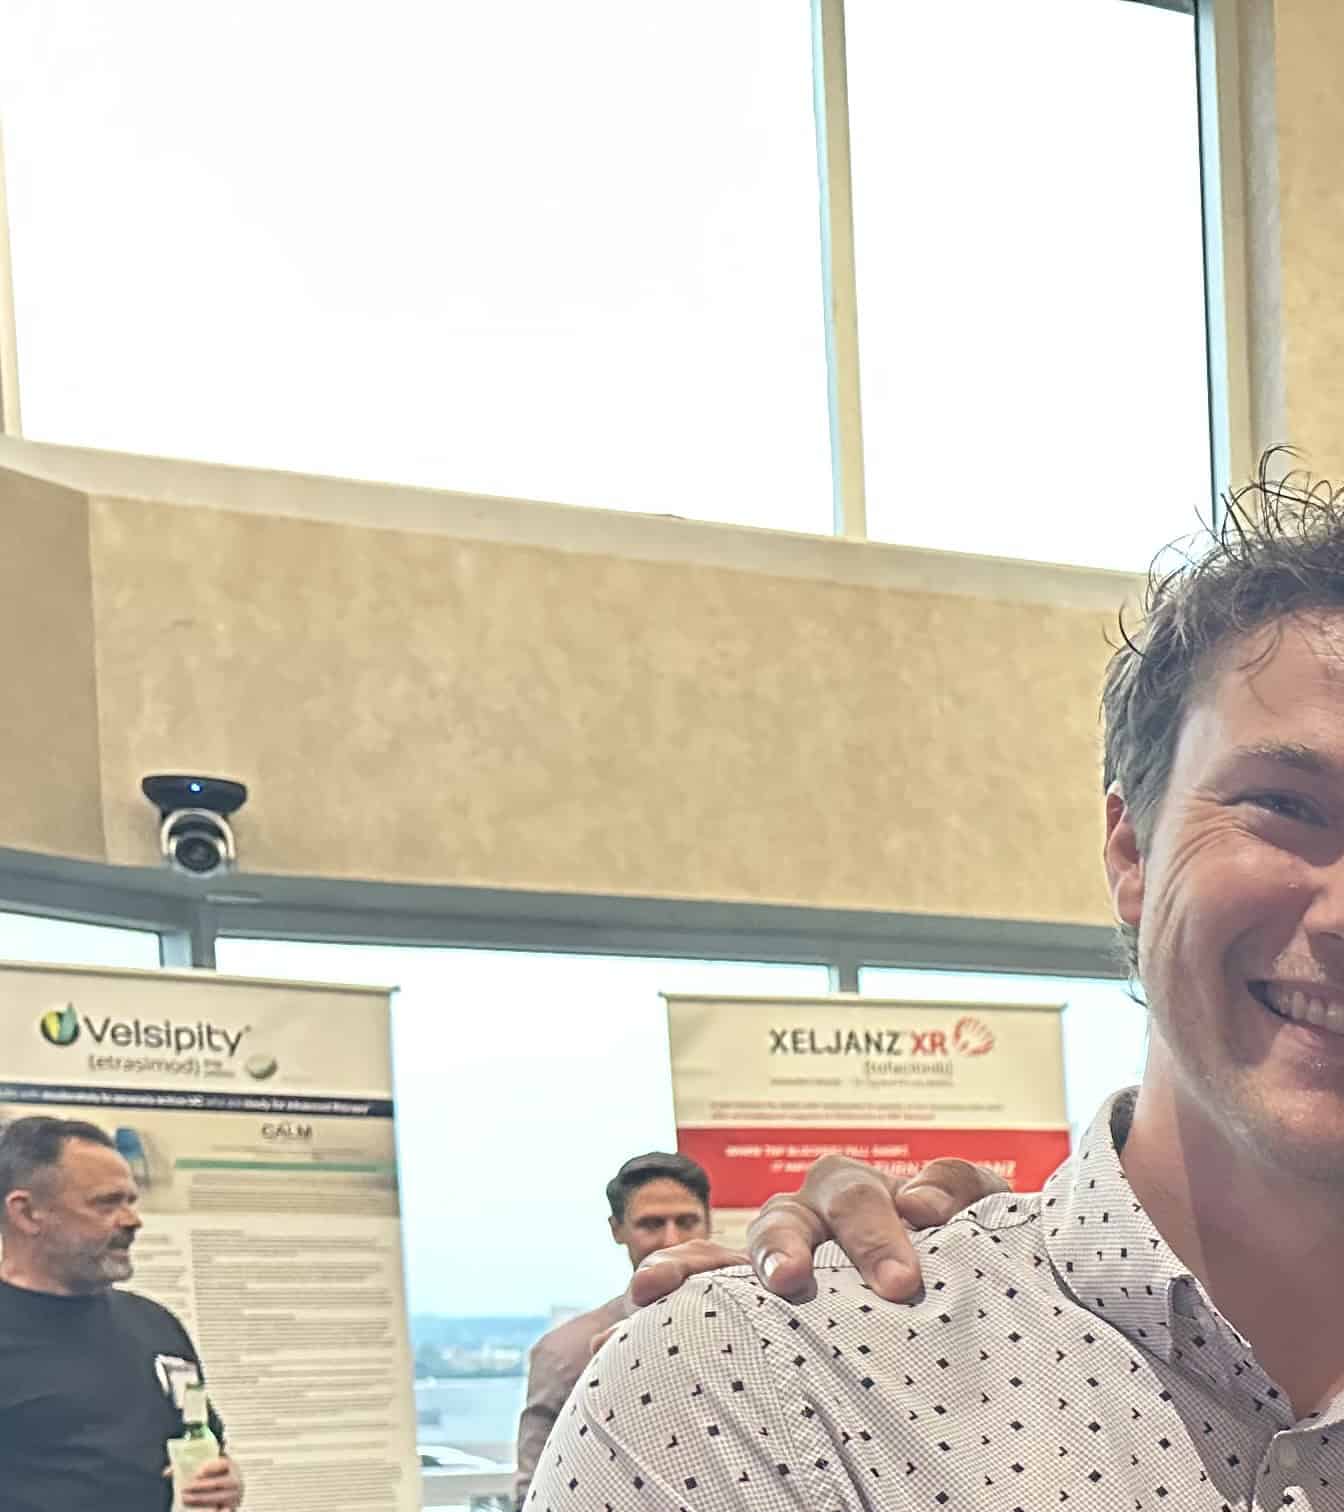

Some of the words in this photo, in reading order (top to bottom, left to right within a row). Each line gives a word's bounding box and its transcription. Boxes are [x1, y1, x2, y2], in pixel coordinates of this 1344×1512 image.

[83, 1016, 244, 1056] Velsipity
[769, 1028, 902, 1056] XELJANZ
[911, 1029, 948, 1056] XR
